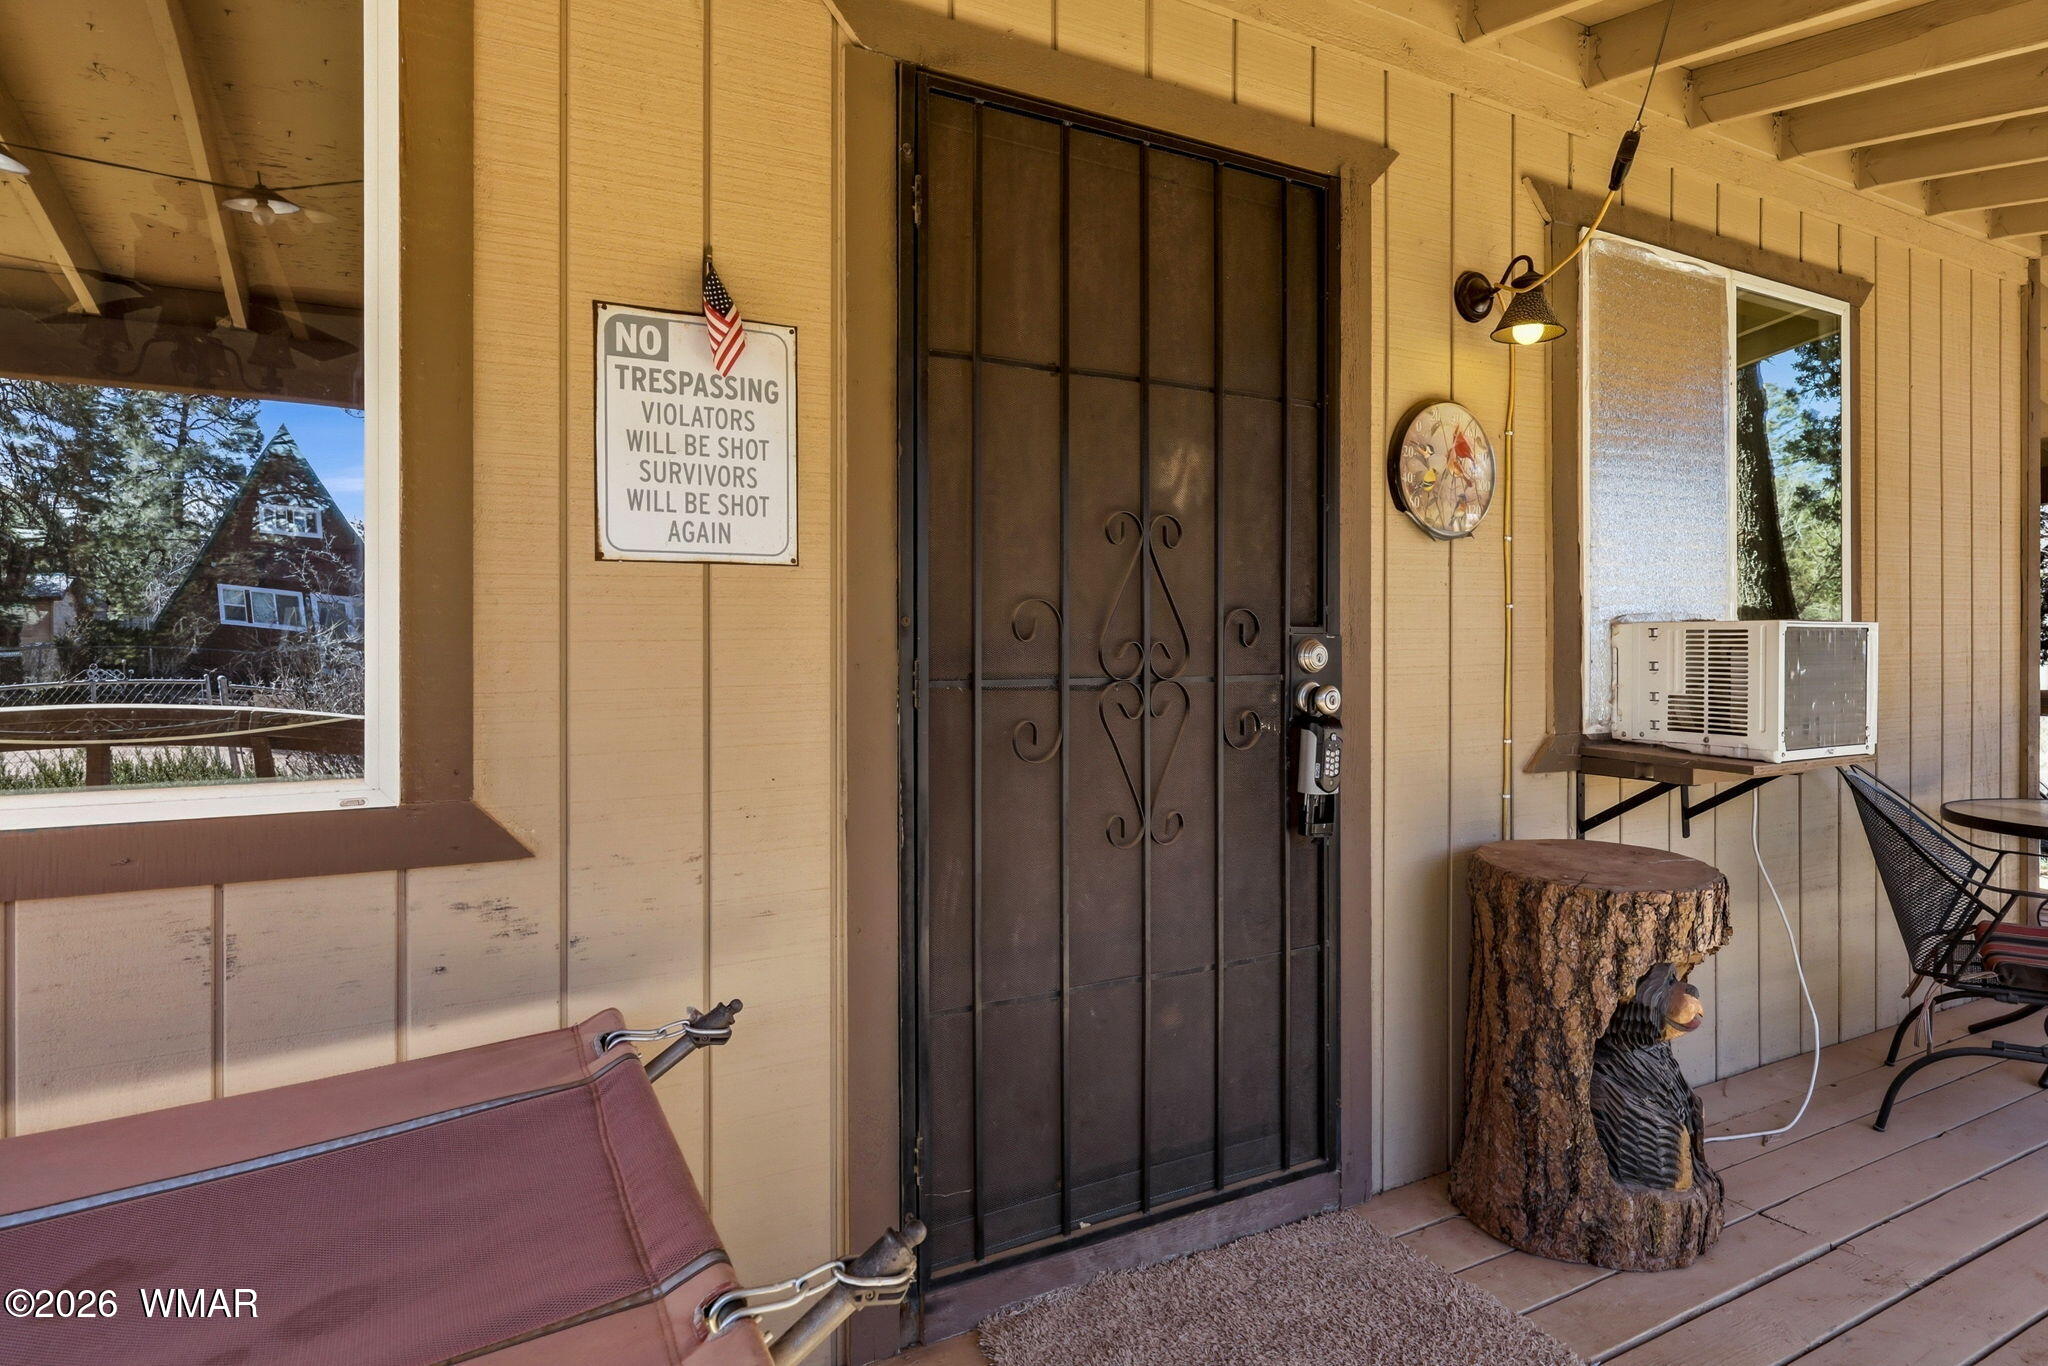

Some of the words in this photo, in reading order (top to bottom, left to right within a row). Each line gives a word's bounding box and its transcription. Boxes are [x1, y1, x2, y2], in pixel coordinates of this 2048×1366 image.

[616, 321, 662, 356] NO
[614, 363, 779, 405] TRESPASSING
[641, 400, 756, 433] VIOLATORS
[626, 428, 677, 455] WILL
[684, 433, 710, 458] BE
[718, 436, 770, 461] SHOT
[639, 459, 758, 489] SURVIVORS
[626, 488, 677, 513] WILL
[684, 491, 710, 515] BE
[718, 493, 770, 518] SHOT
[667, 520, 732, 545] AGAIN
